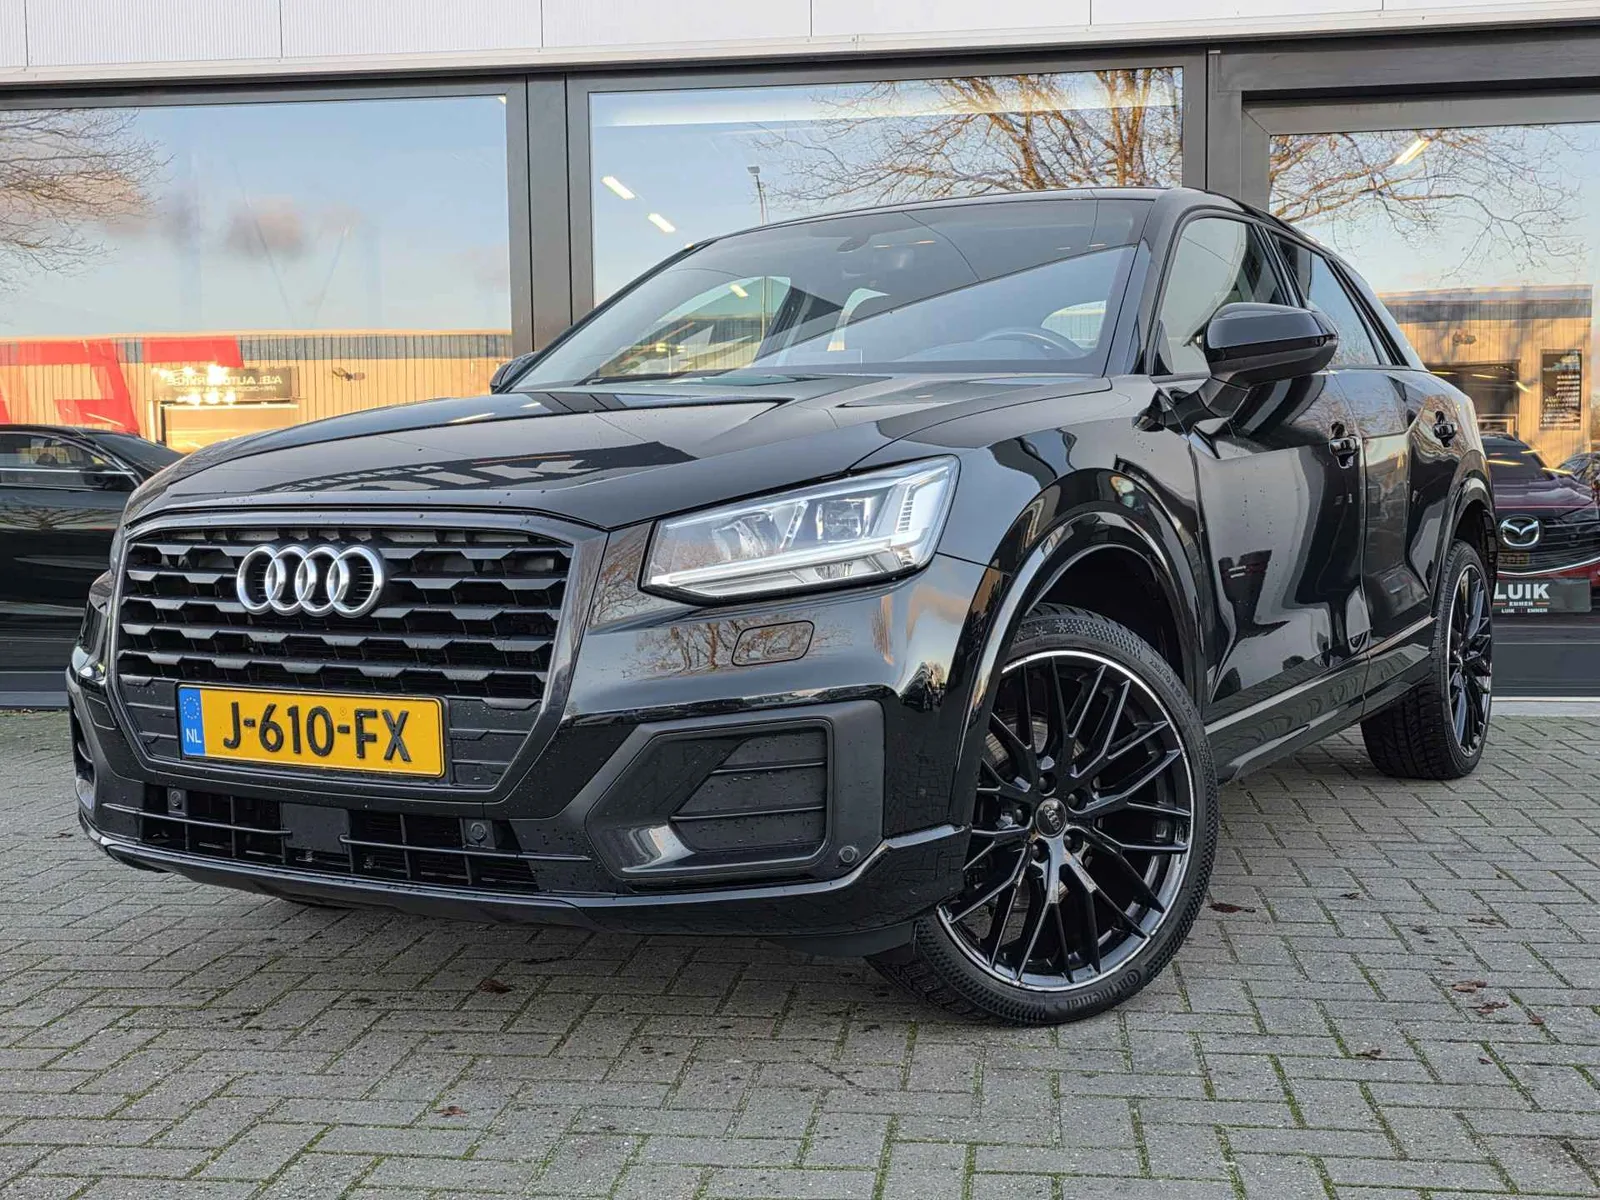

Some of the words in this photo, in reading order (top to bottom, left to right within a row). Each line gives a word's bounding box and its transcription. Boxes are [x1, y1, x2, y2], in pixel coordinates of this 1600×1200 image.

[1493, 582, 1550, 600] LUIK
[185, 727, 202, 744] NL
[222, 701, 413, 763] J-610-FX
